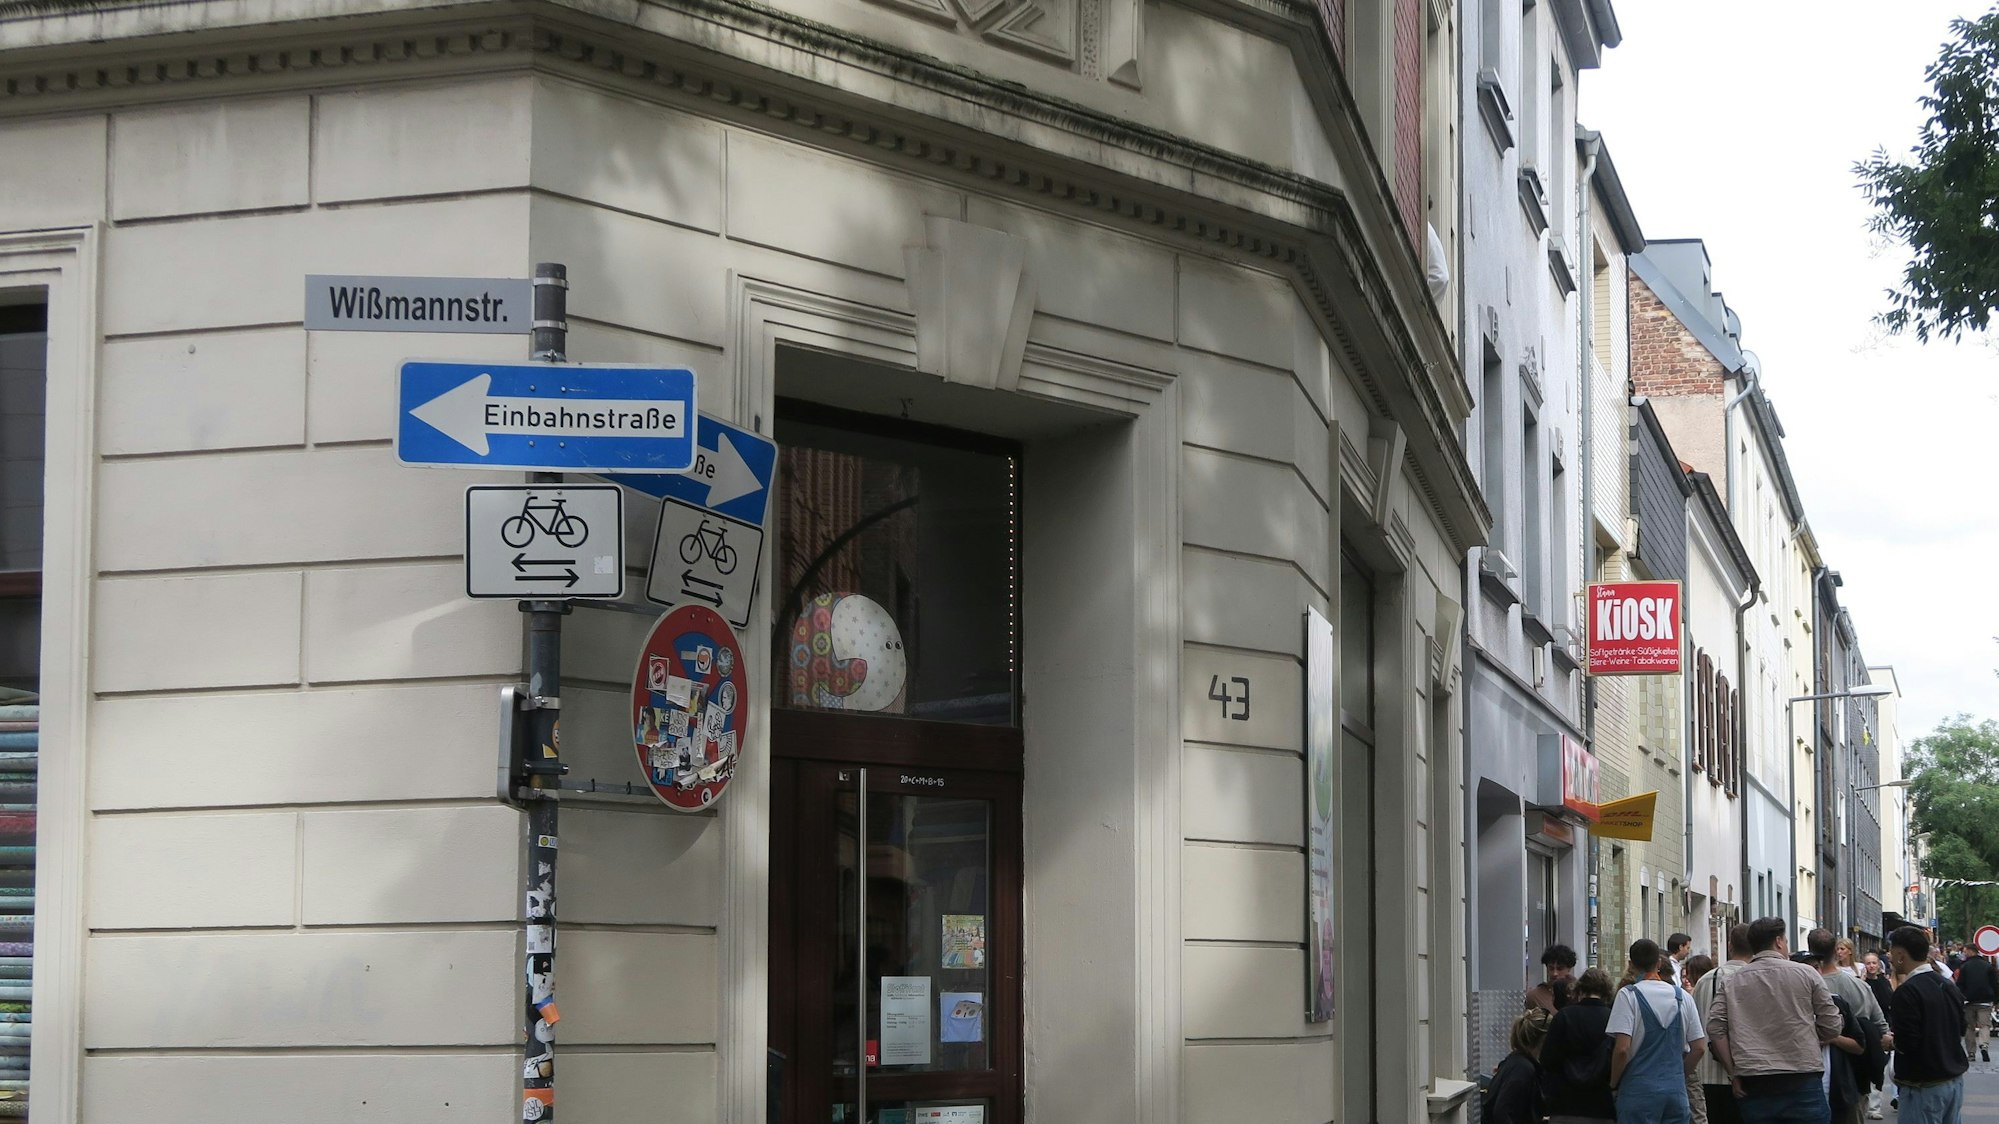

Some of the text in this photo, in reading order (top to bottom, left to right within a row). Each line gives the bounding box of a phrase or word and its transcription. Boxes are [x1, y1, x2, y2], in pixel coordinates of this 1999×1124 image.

[329, 285, 508, 323] Wißmannstr.
[484, 404, 677, 430] Einbahnstraße
[1597, 597, 1674, 641] KiOSK
[1208, 674, 1250, 721] 43
